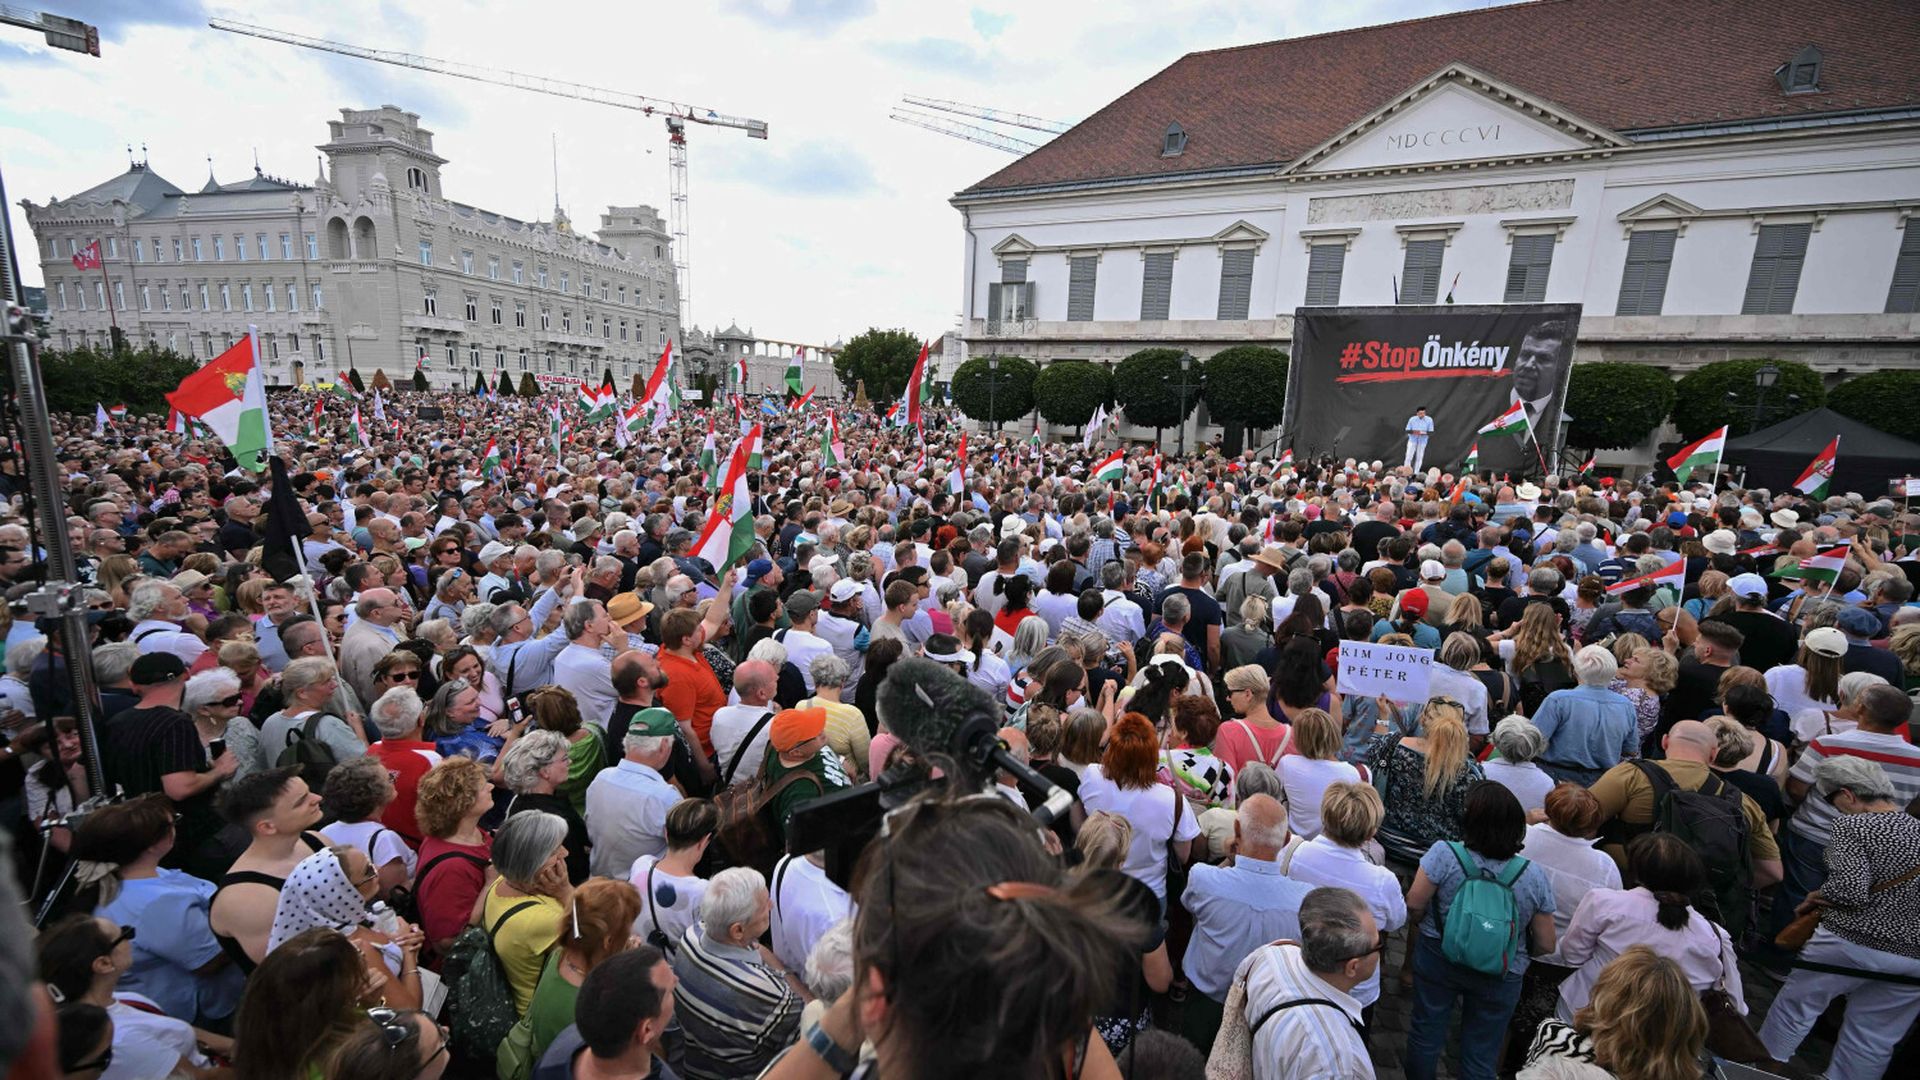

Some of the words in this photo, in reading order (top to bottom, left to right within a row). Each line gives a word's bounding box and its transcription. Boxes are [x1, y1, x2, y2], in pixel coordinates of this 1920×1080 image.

[1386, 124, 1501, 151] MDCCCVI
[1340, 646, 1372, 659] KIM
[1385, 652, 1430, 665] JONG
[1346, 664, 1408, 681] PÉTER
